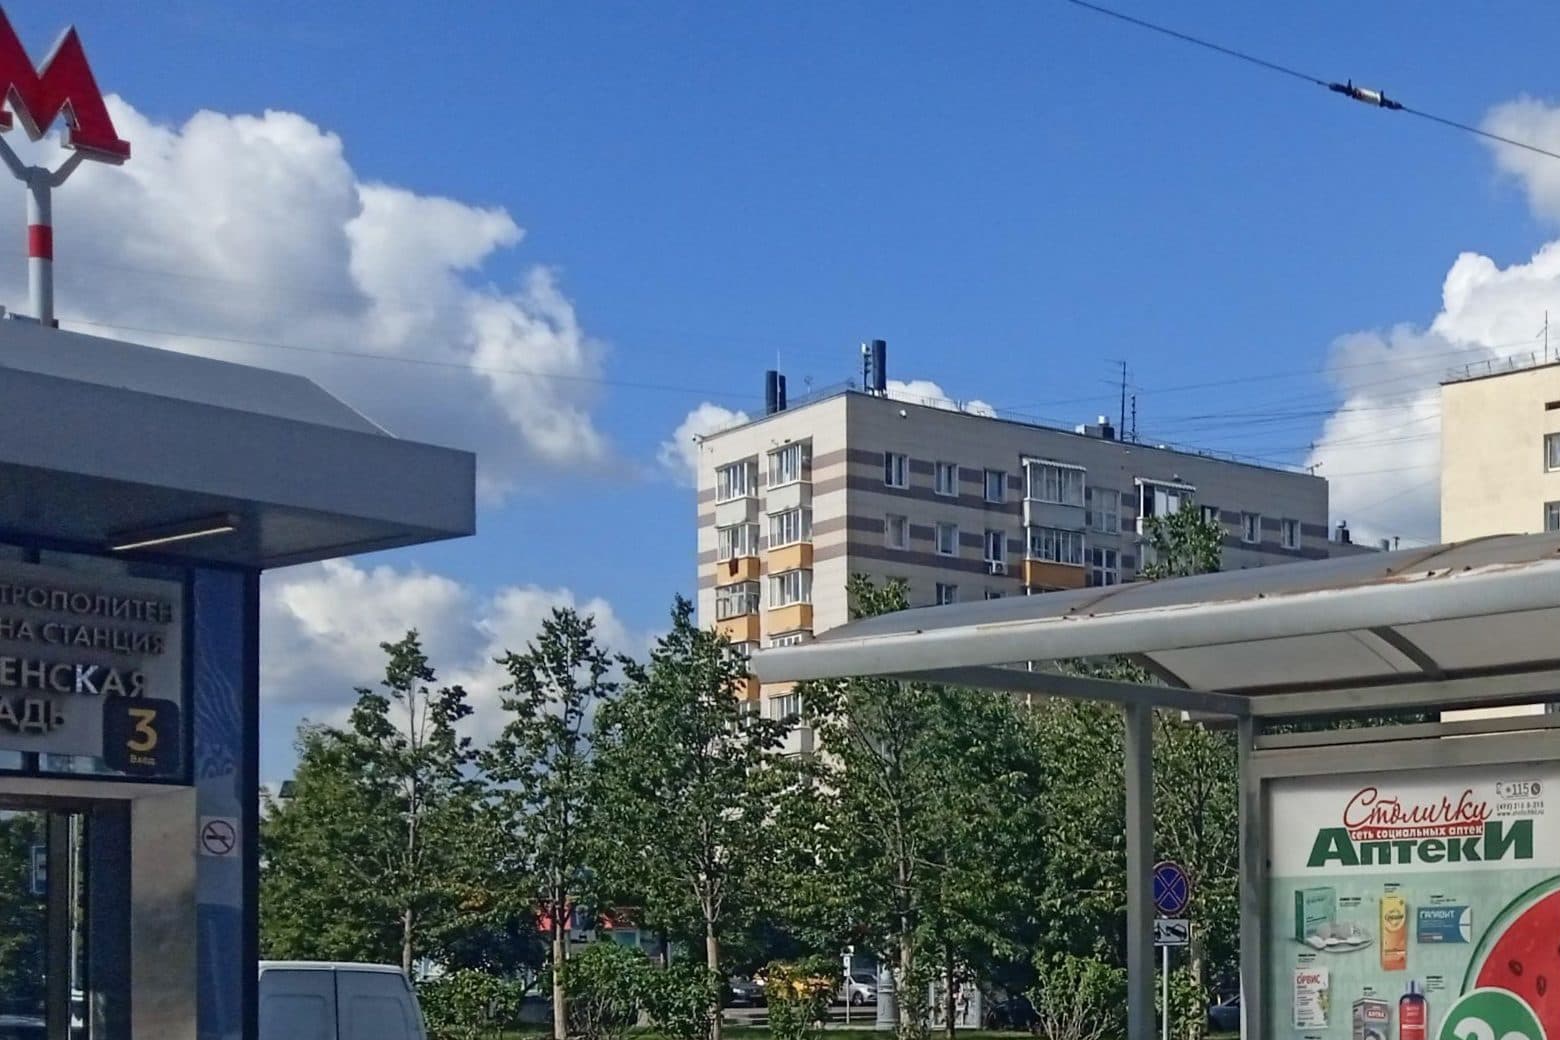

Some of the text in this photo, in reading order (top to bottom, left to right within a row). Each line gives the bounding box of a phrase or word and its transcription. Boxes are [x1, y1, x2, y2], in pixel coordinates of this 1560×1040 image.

[43, 622, 167, 655] СТАНЦИЯ
[0, 656, 146, 698] ЕНСКАЯ
[126, 708, 159, 752] 3
[1344, 786, 1493, 829] Столички
[1351, 823, 1483, 840] сеть социальных аптек
